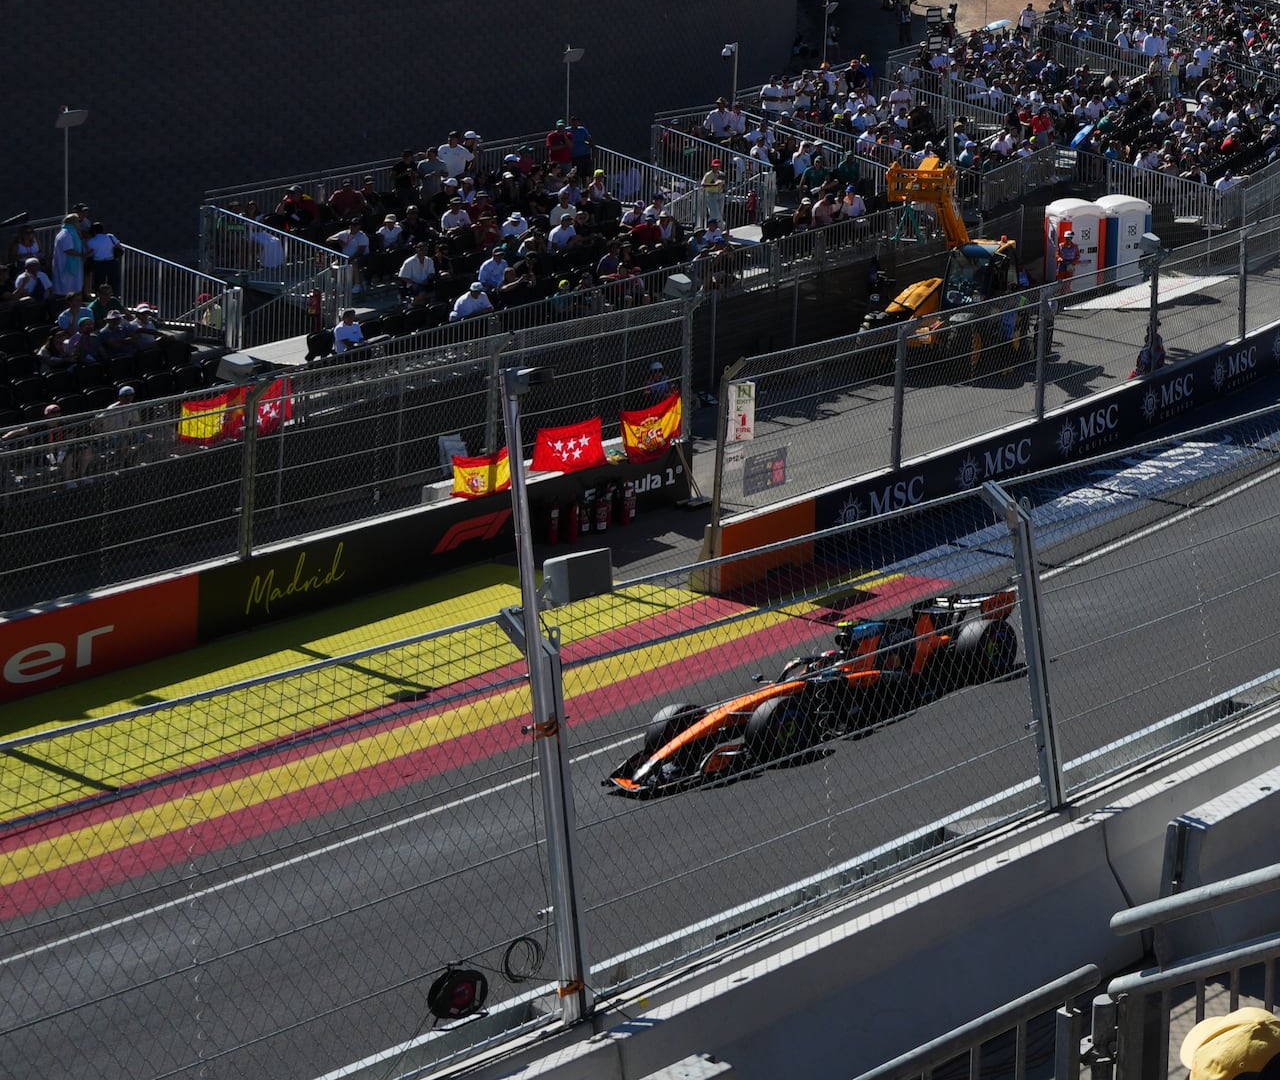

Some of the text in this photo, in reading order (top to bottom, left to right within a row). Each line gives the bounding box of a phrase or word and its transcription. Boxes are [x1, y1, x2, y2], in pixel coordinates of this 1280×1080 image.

[1228, 346, 1257, 377] MSC
[1160, 373, 1194, 408] MSC
[1079, 403, 1119, 441] MSC
[983, 438, 1032, 478] MSC
[870, 475, 924, 516] MSC
[246, 541, 345, 616] Madrid
[3, 624, 115, 684] er
